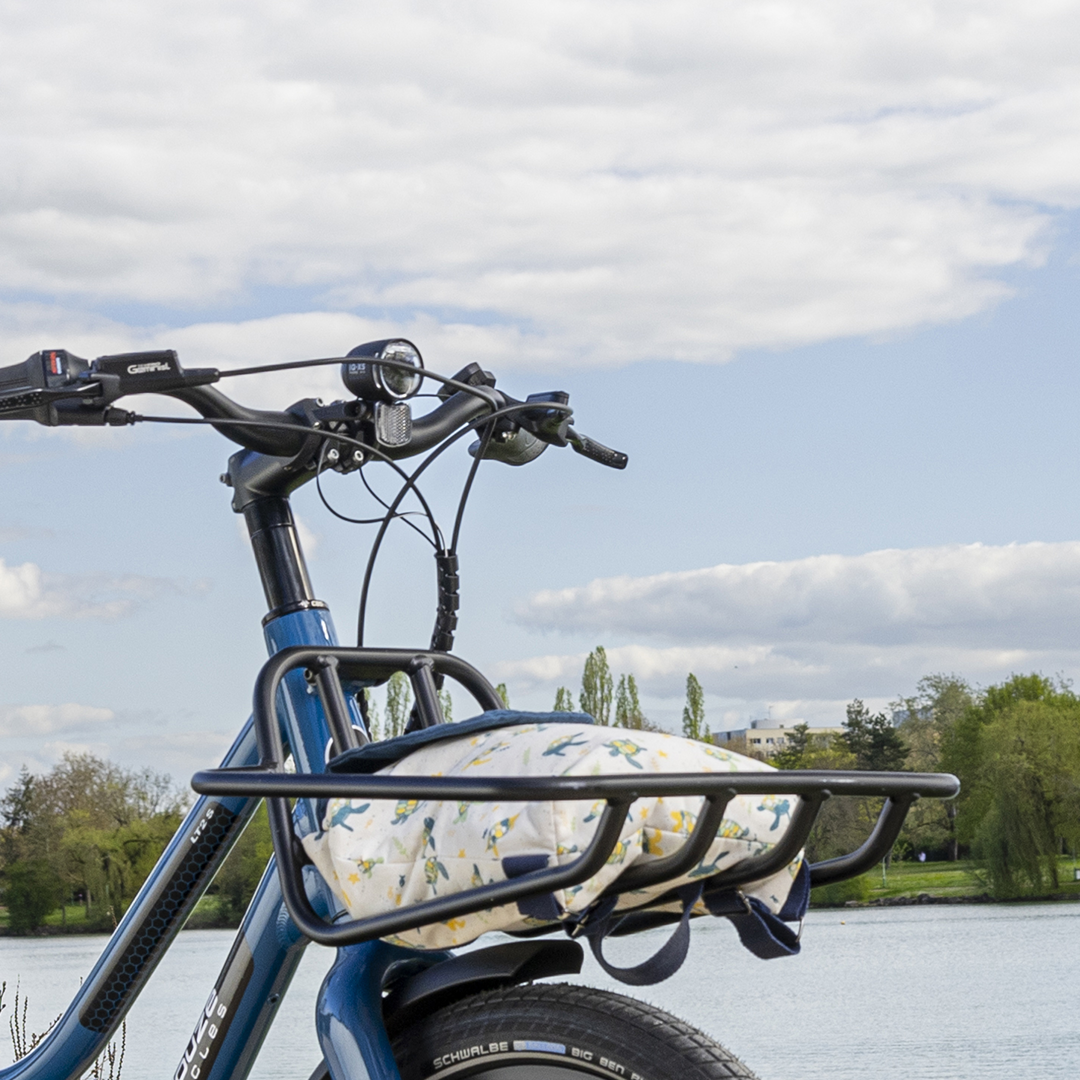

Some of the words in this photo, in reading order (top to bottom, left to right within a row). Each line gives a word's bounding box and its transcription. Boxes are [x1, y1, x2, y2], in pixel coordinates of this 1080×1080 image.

[190, 819, 207, 844] LT2
[206, 808, 214, 819] S
[433, 1041, 509, 1069] SCHWALBE
[571, 1047, 593, 1061] BIG
[599, 1057, 625, 1075] BEN
